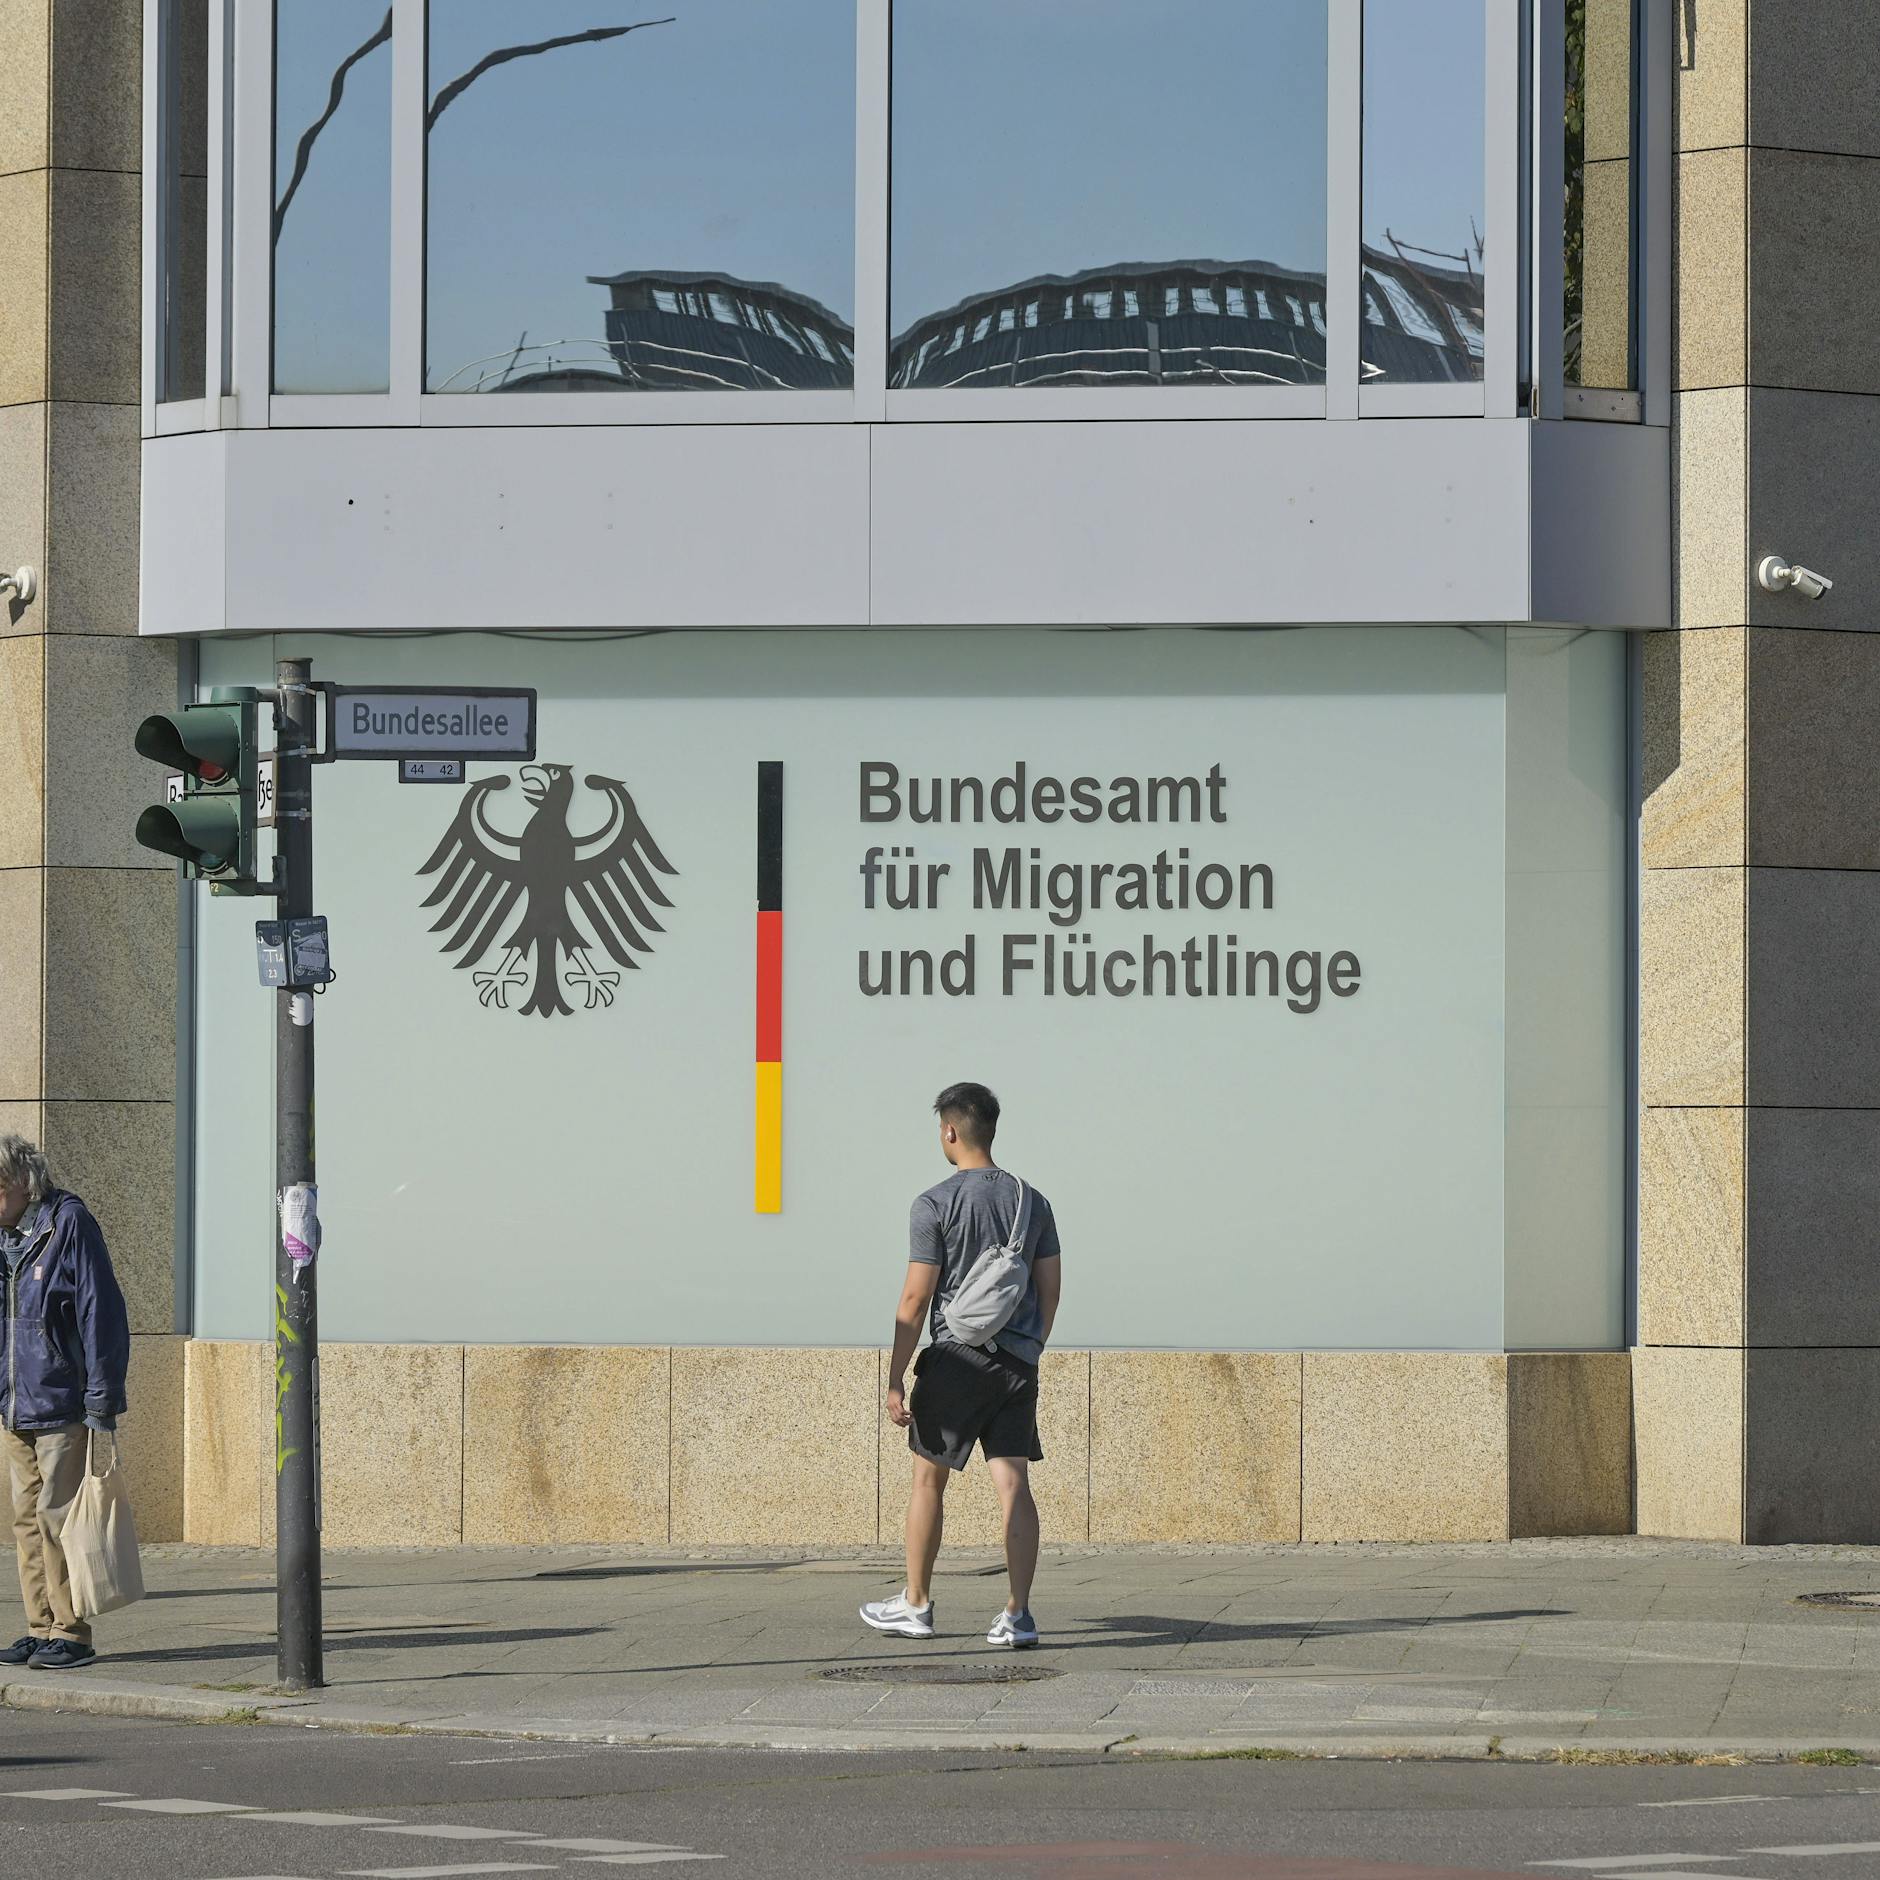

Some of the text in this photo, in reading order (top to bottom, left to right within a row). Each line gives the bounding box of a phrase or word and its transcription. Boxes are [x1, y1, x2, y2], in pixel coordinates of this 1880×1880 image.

[353, 702, 509, 736] Bundesallee
[410, 764, 454, 776] 44 42
[859, 761, 1227, 823] Bundesamt
[859, 846, 1274, 927] für Migration
[859, 933, 1361, 1014] und Flüchtlinge
